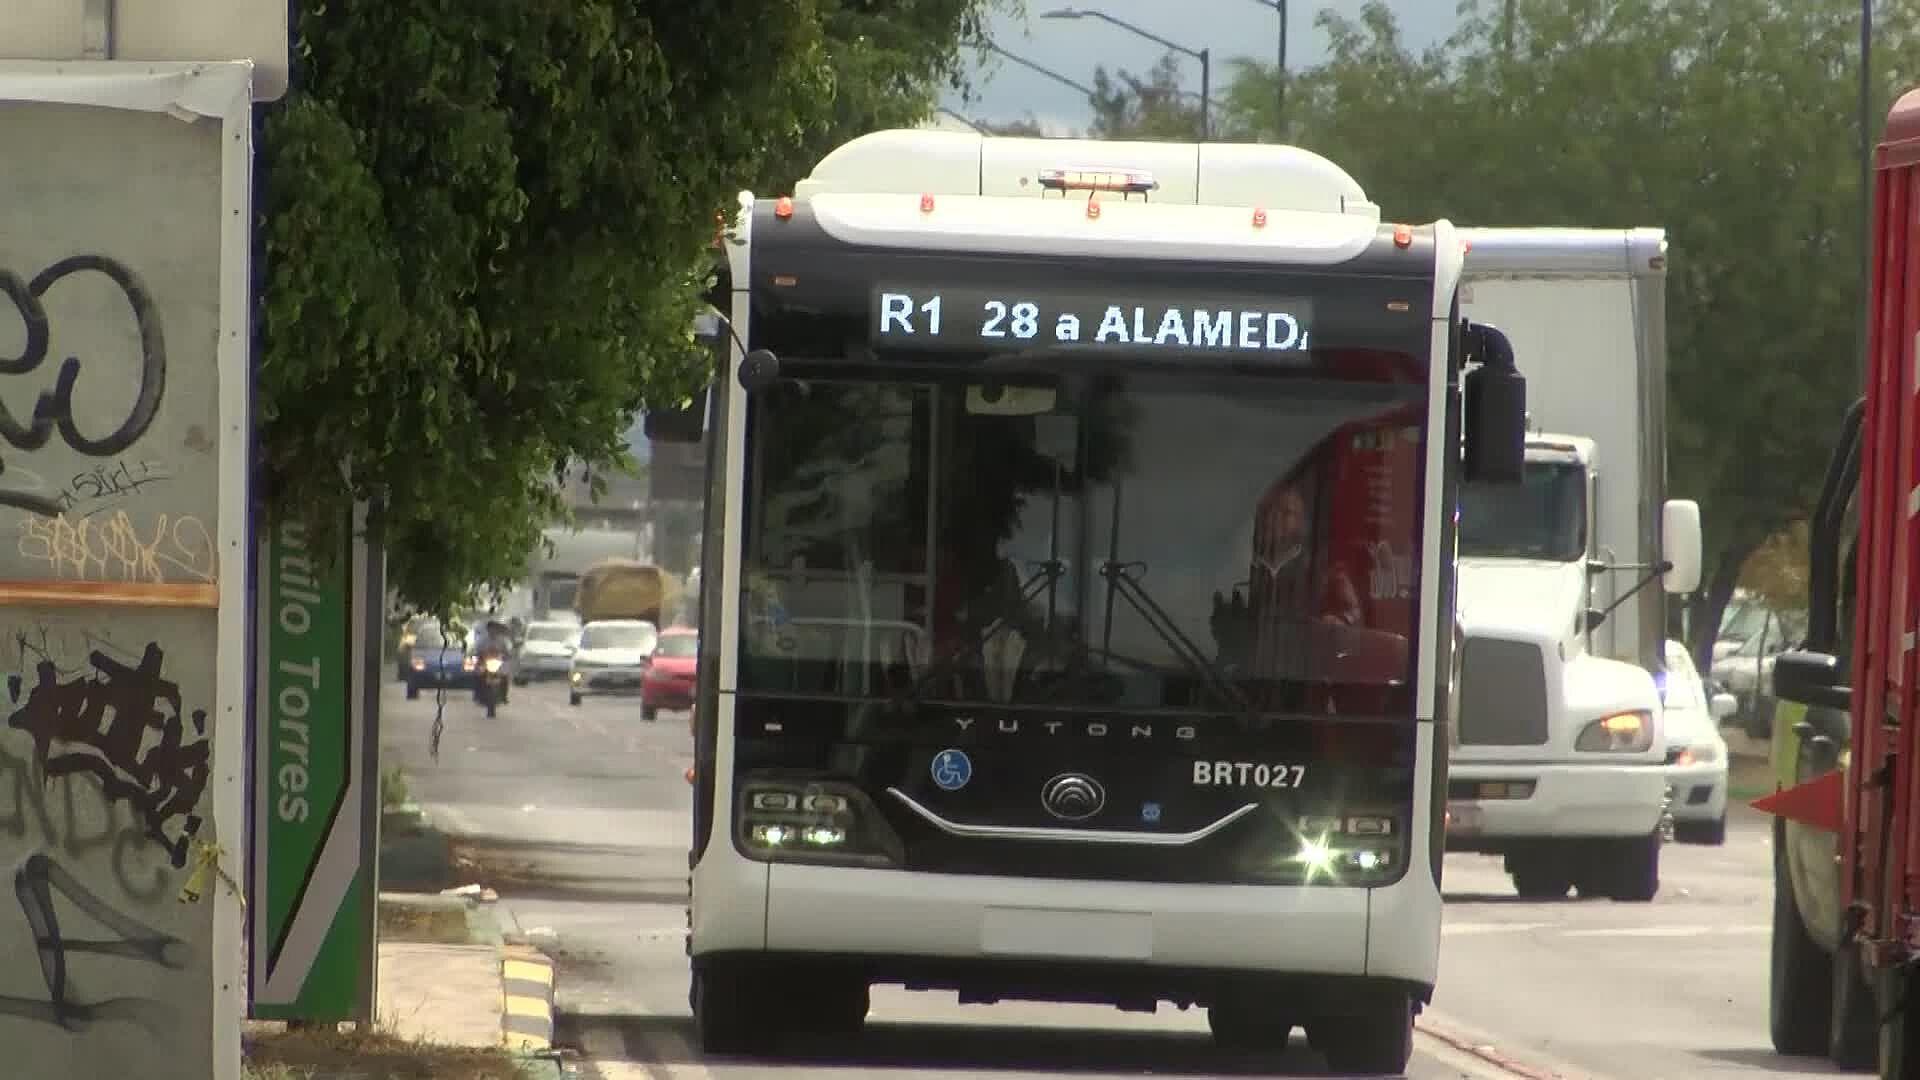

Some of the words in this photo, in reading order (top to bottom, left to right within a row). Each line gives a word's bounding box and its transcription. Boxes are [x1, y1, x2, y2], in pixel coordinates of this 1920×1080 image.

[879, 293, 942, 335] R1
[981, 301, 1040, 339] 28
[1055, 313, 1080, 341] a
[1094, 305, 1308, 351] ALAMED
[279, 517, 321, 636] utilo
[278, 656, 321, 823] Torres
[955, 718, 1196, 740] YUTONG
[1192, 760, 1305, 788] BRT027
